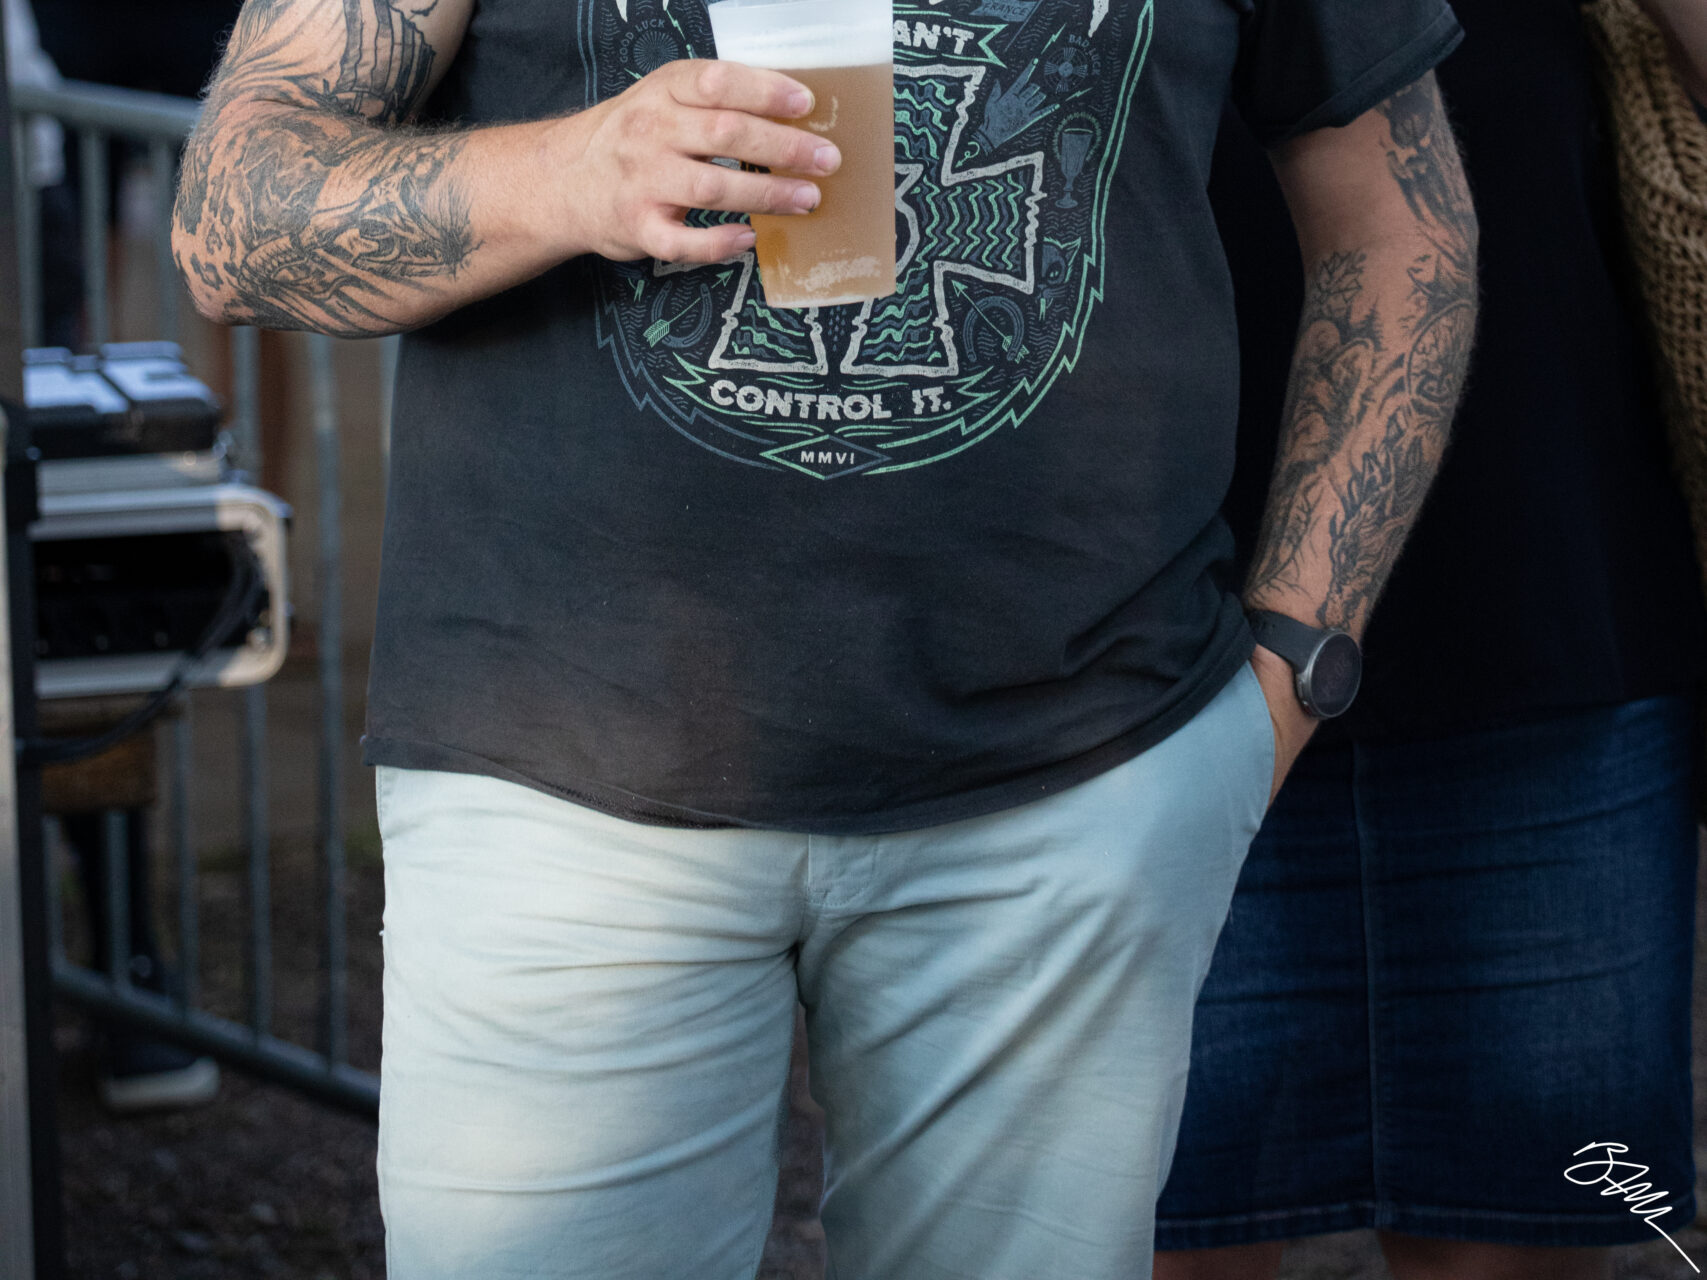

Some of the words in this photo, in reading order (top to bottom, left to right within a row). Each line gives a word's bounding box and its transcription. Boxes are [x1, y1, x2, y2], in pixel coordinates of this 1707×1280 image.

[982, 1, 1028, 16] FRANCE
[619, 31, 635, 63] GOOD
[635, 18, 666, 33] LUCK
[893, 20, 975, 55] AN'T
[1068, 33, 1090, 48] BAD
[1088, 47, 1101, 76] LUCK
[709, 379, 892, 420] CONTROL
[911, 386, 952, 415] IT.
[800, 451, 855, 465] MMVI
